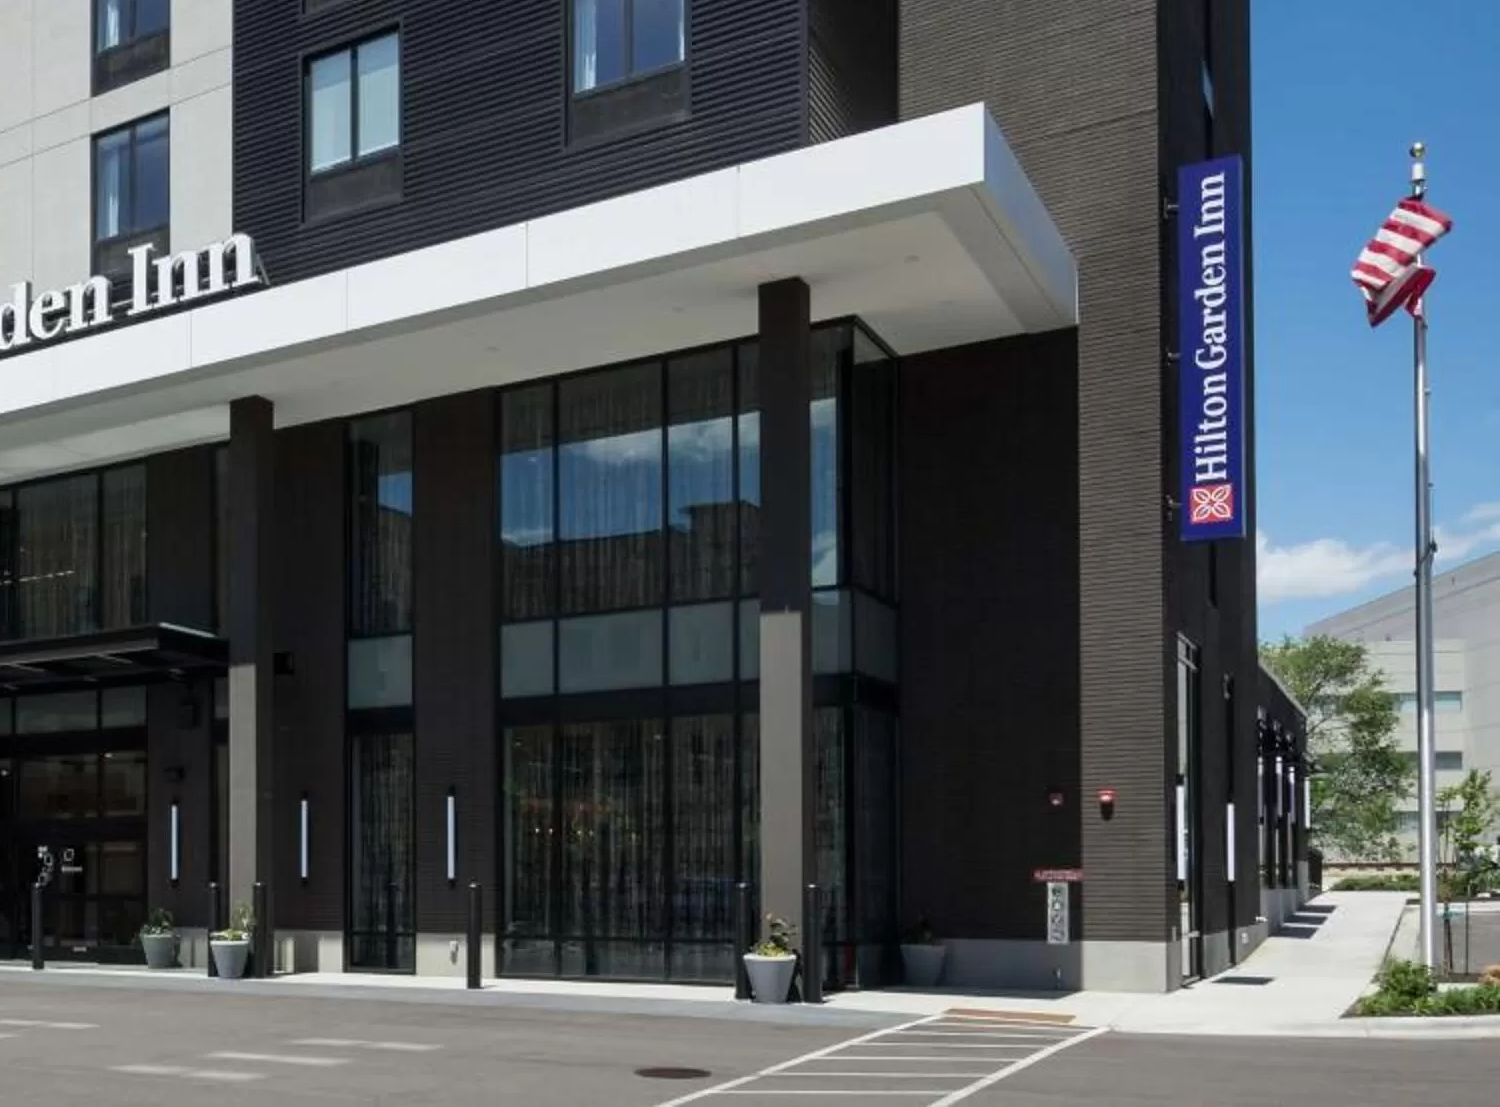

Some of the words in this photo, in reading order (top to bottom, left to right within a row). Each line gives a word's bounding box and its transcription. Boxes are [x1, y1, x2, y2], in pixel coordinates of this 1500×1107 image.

[1194, 171, 1225, 240] Inn
[127, 232, 260, 314] Inn
[1194, 240, 1227, 370] Garden
[1194, 372, 1227, 483] Hilton
